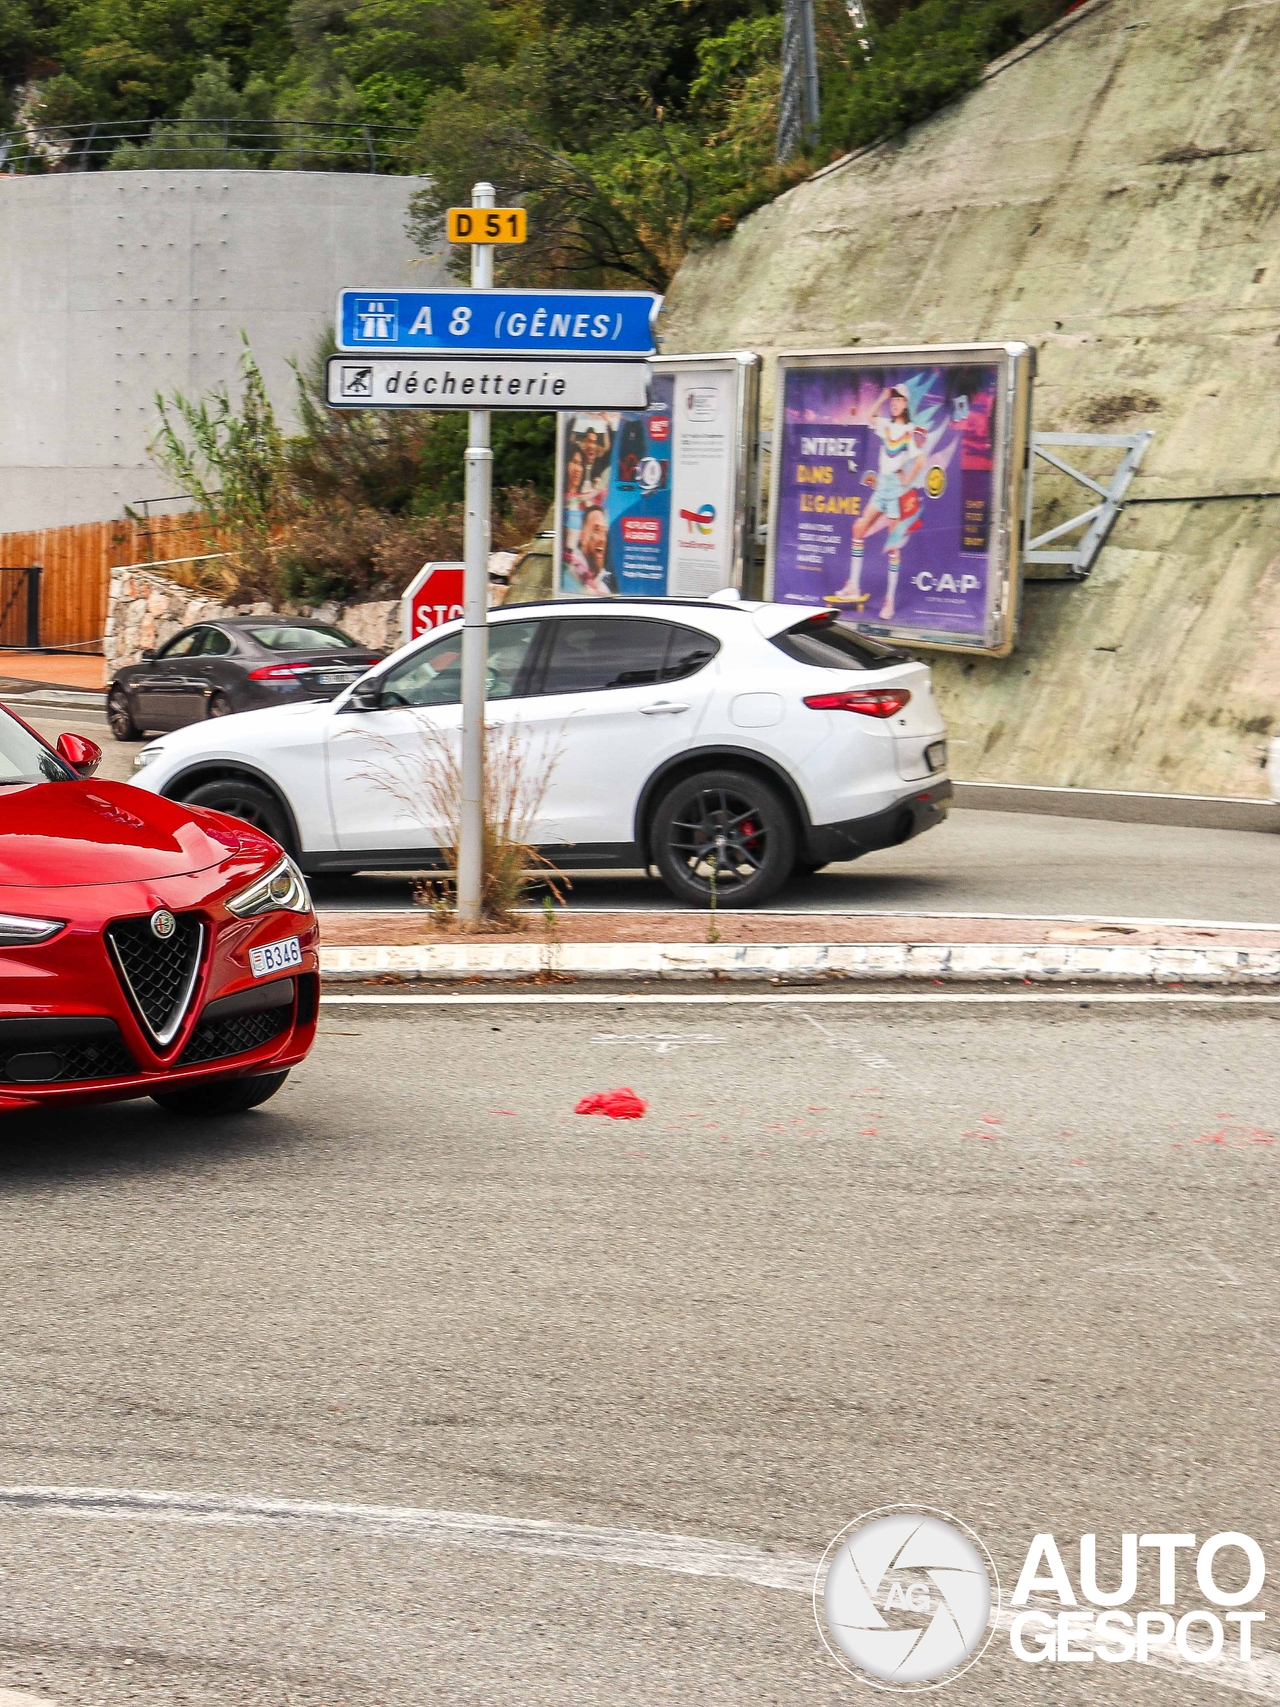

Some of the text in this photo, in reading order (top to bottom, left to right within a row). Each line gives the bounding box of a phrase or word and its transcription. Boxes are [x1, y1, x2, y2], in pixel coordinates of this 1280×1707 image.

[455, 213, 518, 238] D 51
[408, 306, 623, 341] A 8 (GÊNES)
[385, 370, 567, 396] déchetterie
[797, 464, 834, 484] DANS
[415, 604, 465, 634] STO
[265, 941, 299, 969] B346
